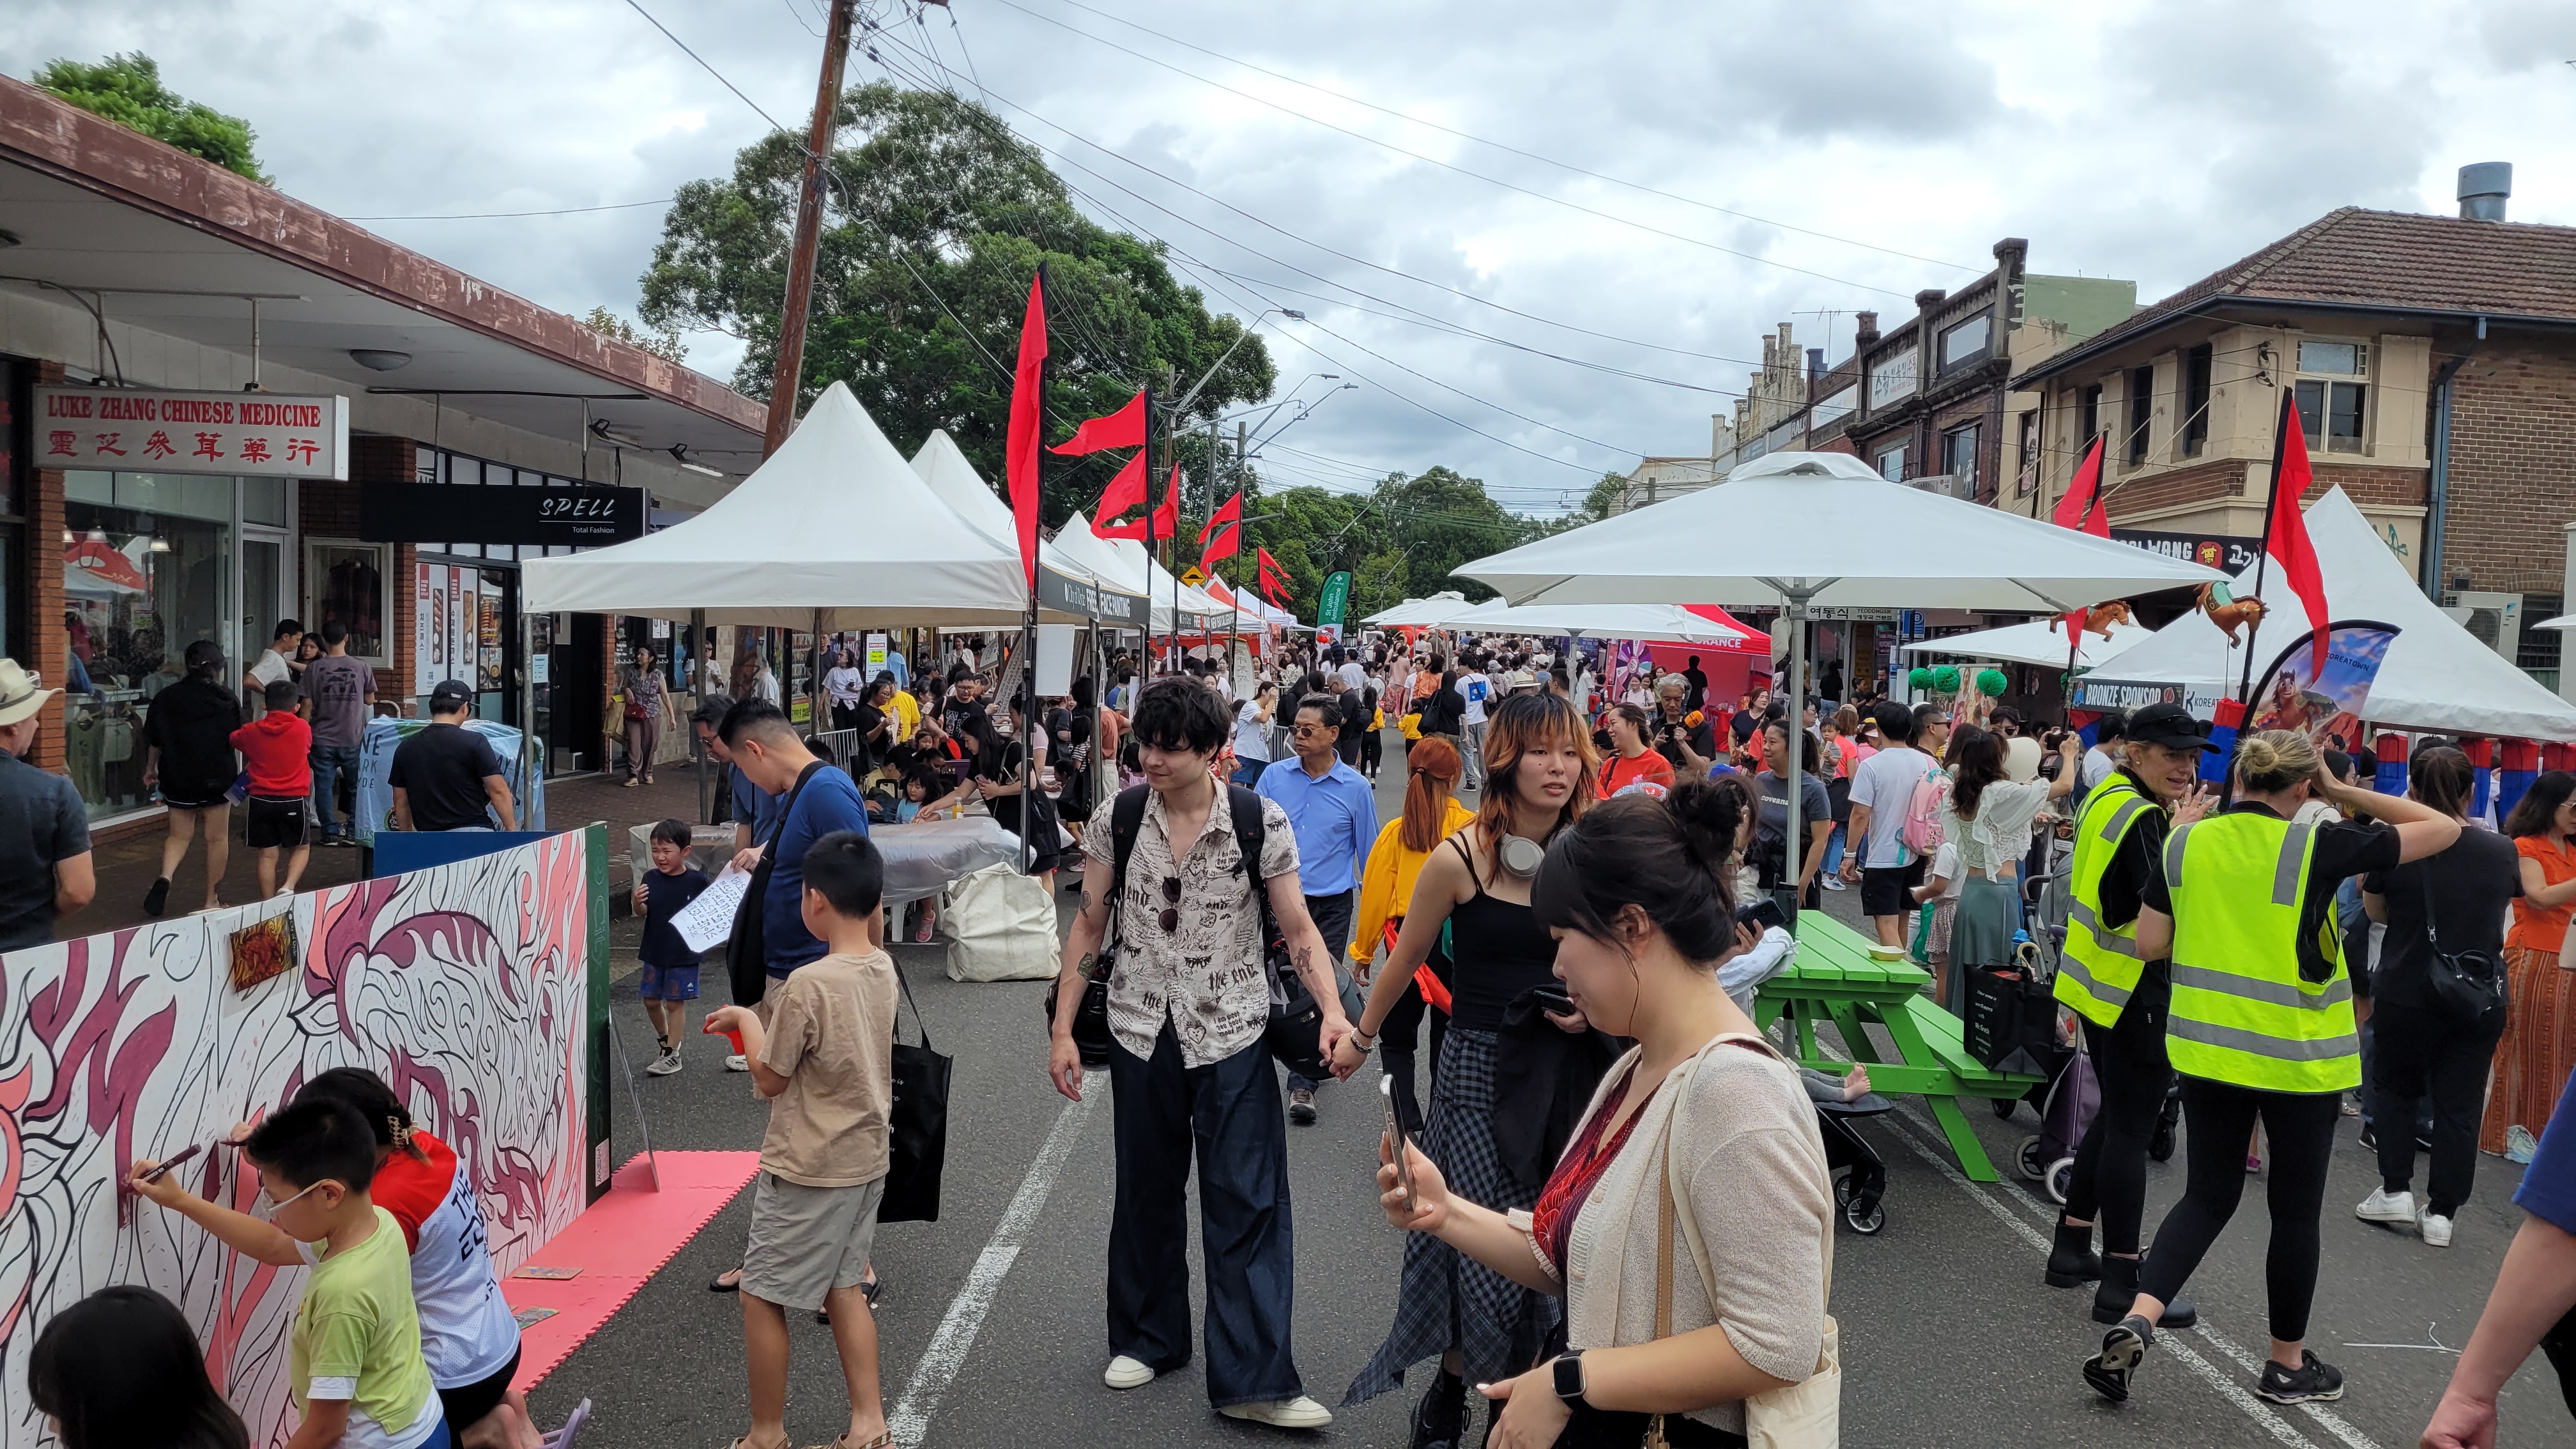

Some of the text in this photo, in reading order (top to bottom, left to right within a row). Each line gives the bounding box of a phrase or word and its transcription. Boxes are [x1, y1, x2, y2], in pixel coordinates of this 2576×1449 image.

[48, 395, 321, 427] LUKE ZHANG CHINESE MEDICINE
[539, 498, 615, 517] SPELL
[2148, 540, 2193, 560] WANG
[1086, 588, 1098, 613] FREE
[1100, 592, 1112, 616] FACE
[1112, 595, 1130, 618] PAINTING
[1331, 588, 1341, 622] Ambulance
[1810, 608, 1849, 619] 여동식
[2085, 684, 2120, 708] BRONZE
